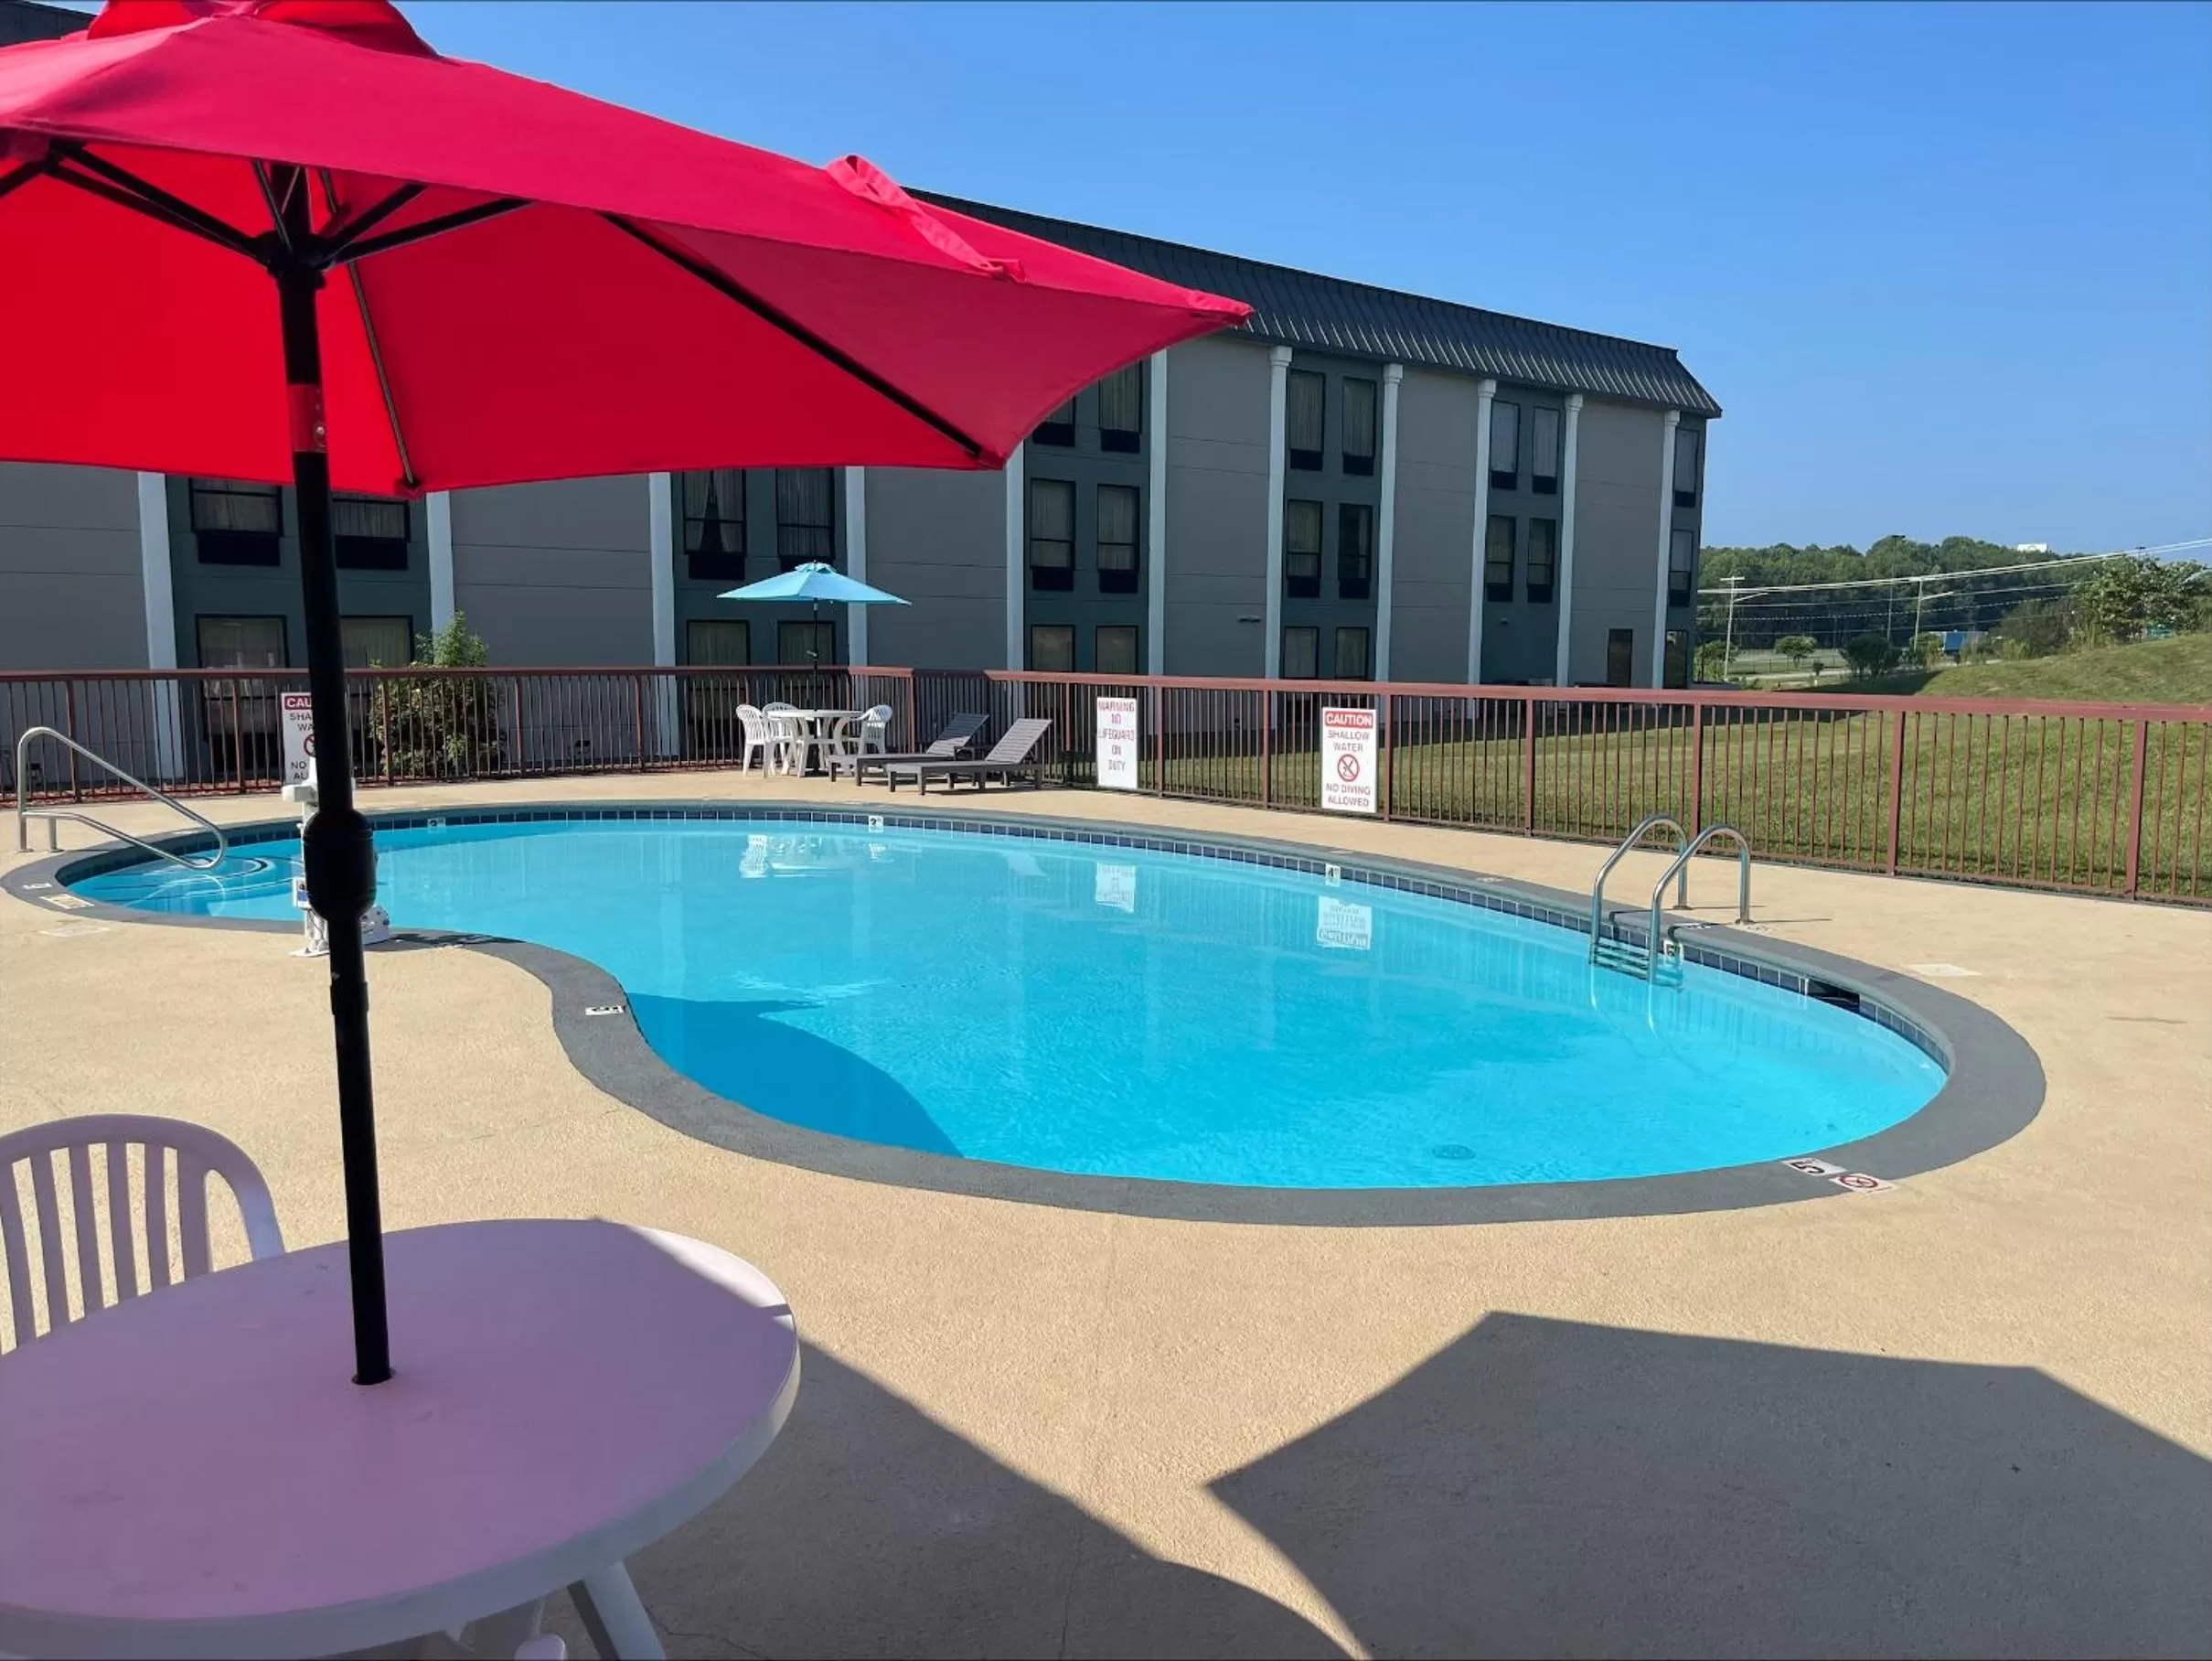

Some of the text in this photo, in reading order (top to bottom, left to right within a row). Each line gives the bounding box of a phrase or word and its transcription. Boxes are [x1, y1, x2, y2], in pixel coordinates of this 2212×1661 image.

[1098, 701, 1135, 712] WARNING
[1111, 713, 1122, 724] NO
[1326, 713, 1372, 725] CAUTION
[1327, 730, 1370, 741] SHALLOW
[1111, 745, 1122, 755] ON
[1333, 742, 1363, 752] WATER
[291, 760, 307, 769] NO
[1325, 783, 1371, 796] NO DIVING
[1328, 795, 1370, 807] ALLOWED
[1790, 1159, 1825, 1173] 5
